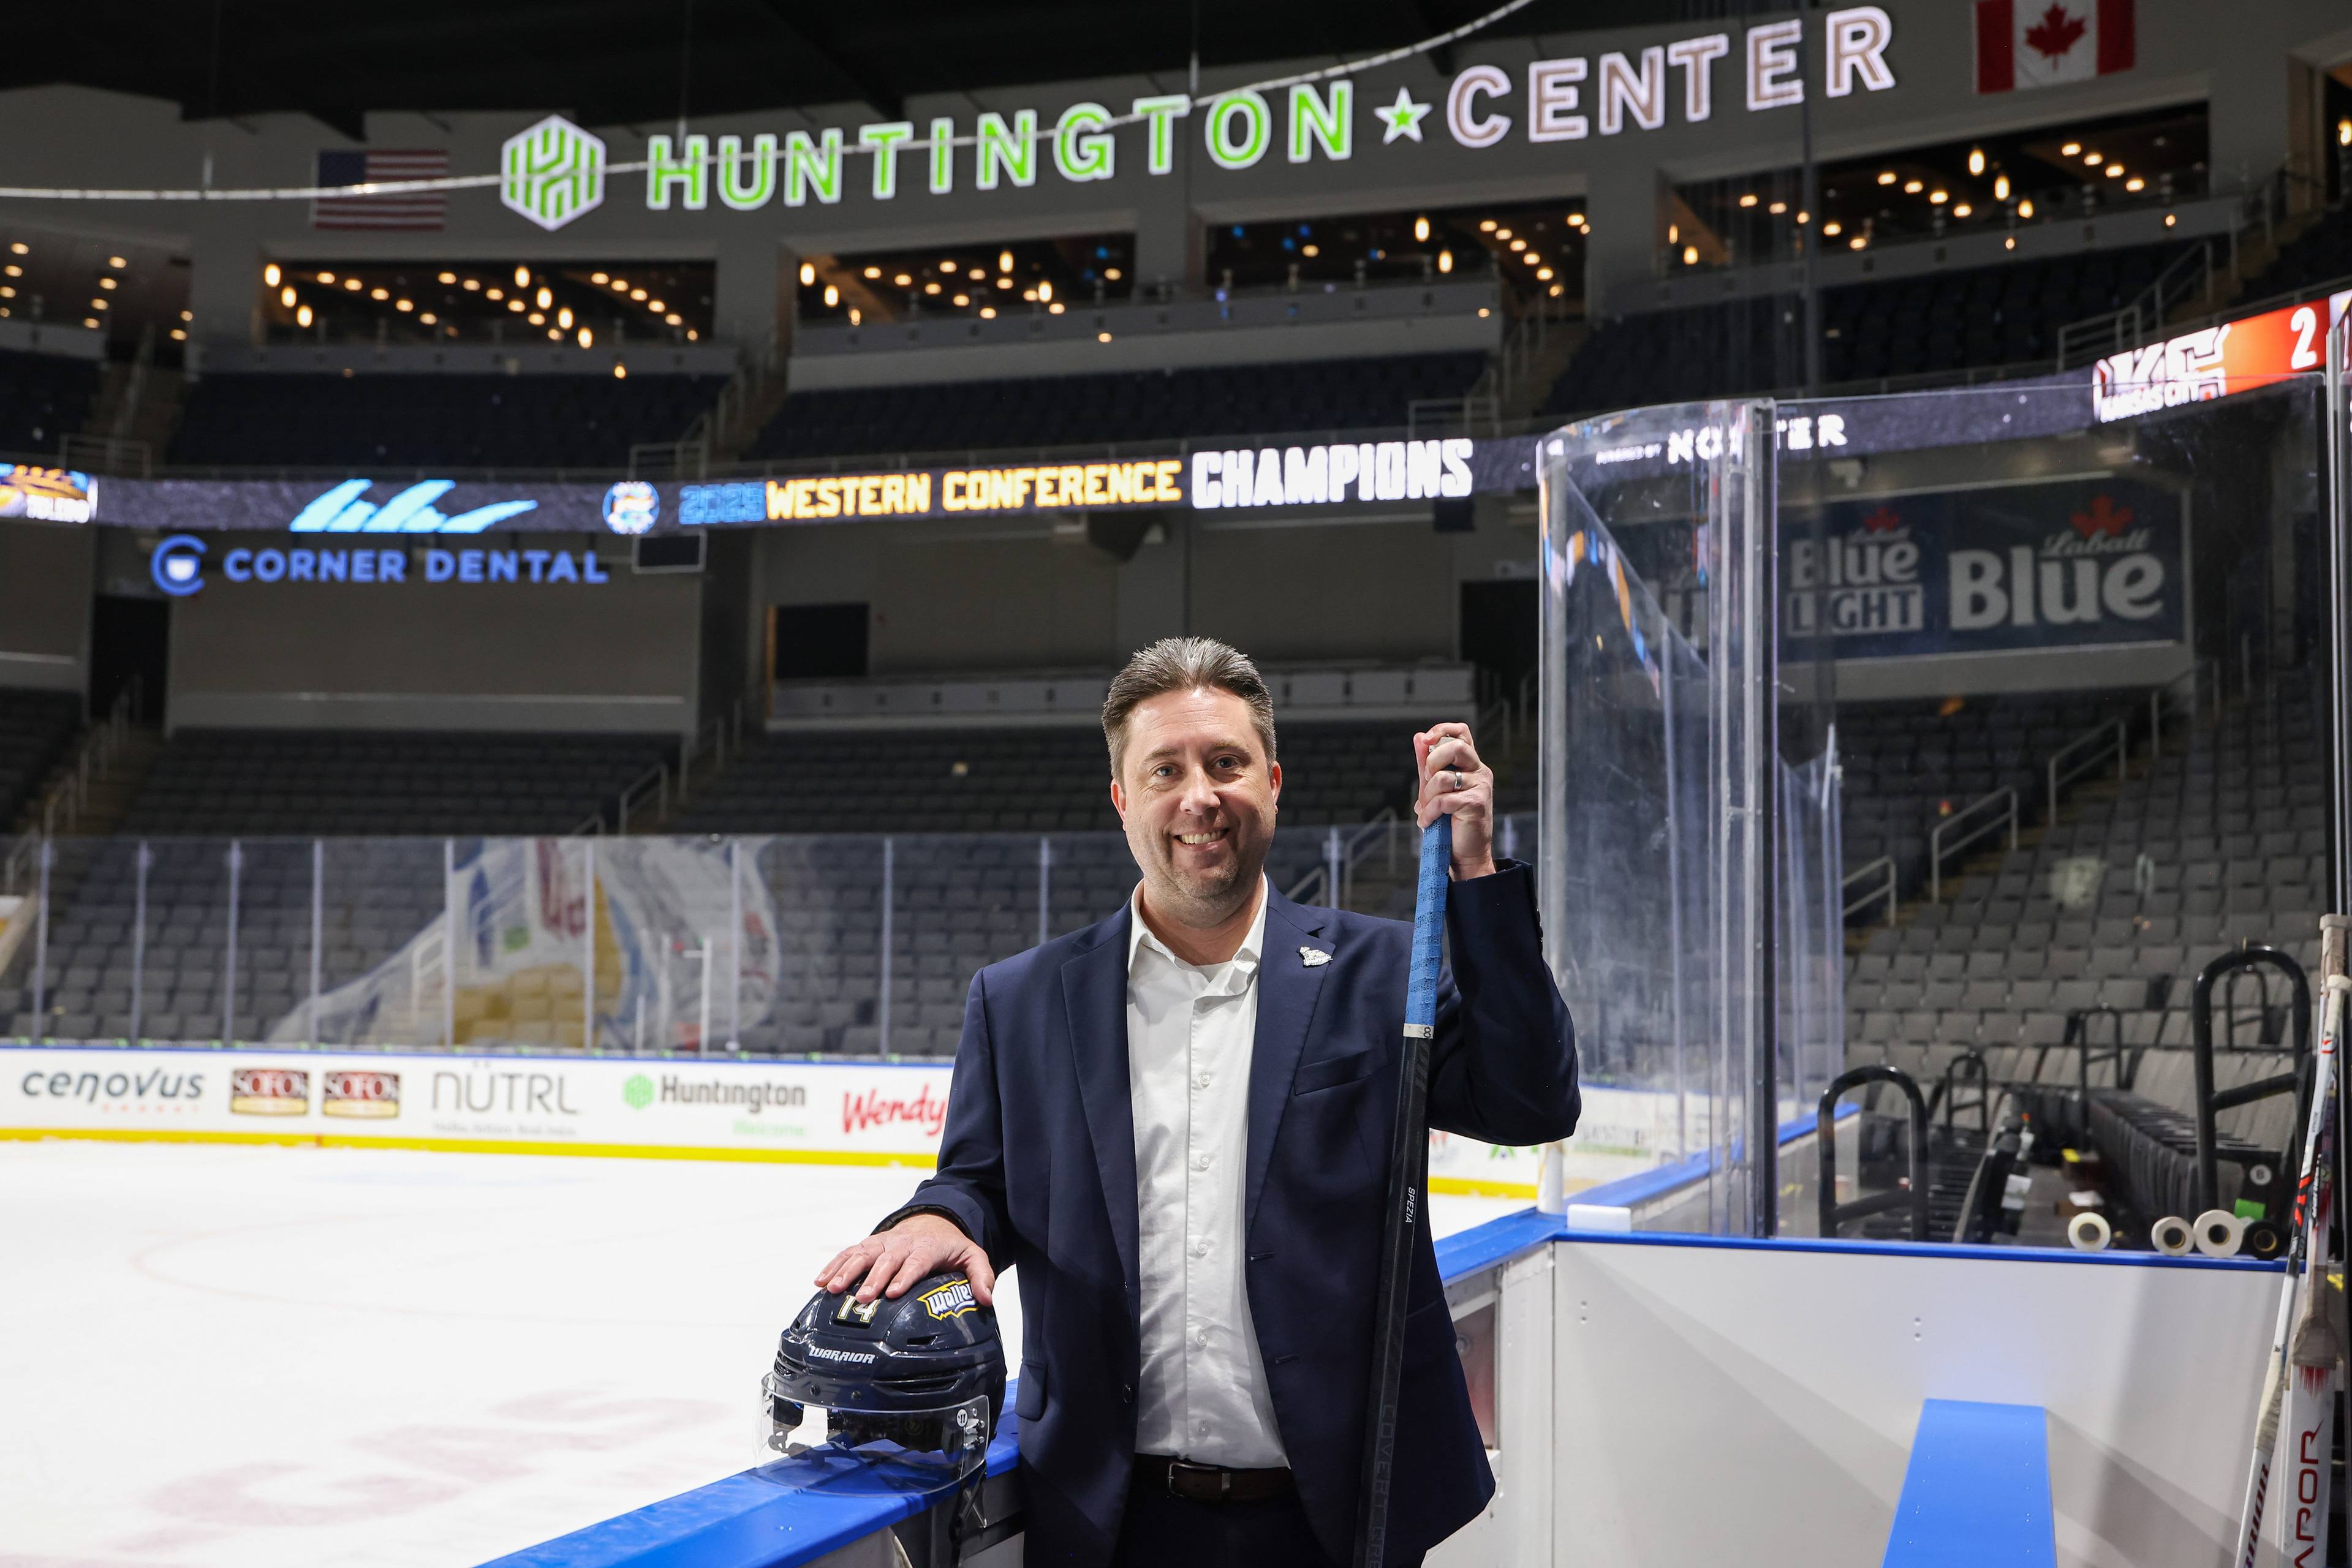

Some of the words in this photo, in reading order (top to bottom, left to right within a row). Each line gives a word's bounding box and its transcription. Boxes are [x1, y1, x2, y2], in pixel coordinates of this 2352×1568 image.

[646, 80, 1353, 209] HUNTINGTON
[1446, 5, 1895, 148] CENTER
[2290, 307, 2317, 369] 2
[765, 473, 931, 521] WESTERN
[943, 461, 1182, 511] CONFERENCE
[1192, 438, 1473, 509] CHAMPIONS
[223, 548, 406, 583] CORNER
[425, 549, 610, 585] DENTAL
[1948, 545, 2165, 630] Blue
[1790, 587, 1920, 633] LGHT
[22, 1068, 205, 1104] cenovus
[660, 1074, 806, 1115] Huntington
[1405, 1186, 1415, 1223] SPEZIA
[837, 1294, 882, 1323] 14
[808, 1346, 875, 1364] WARRIOR
